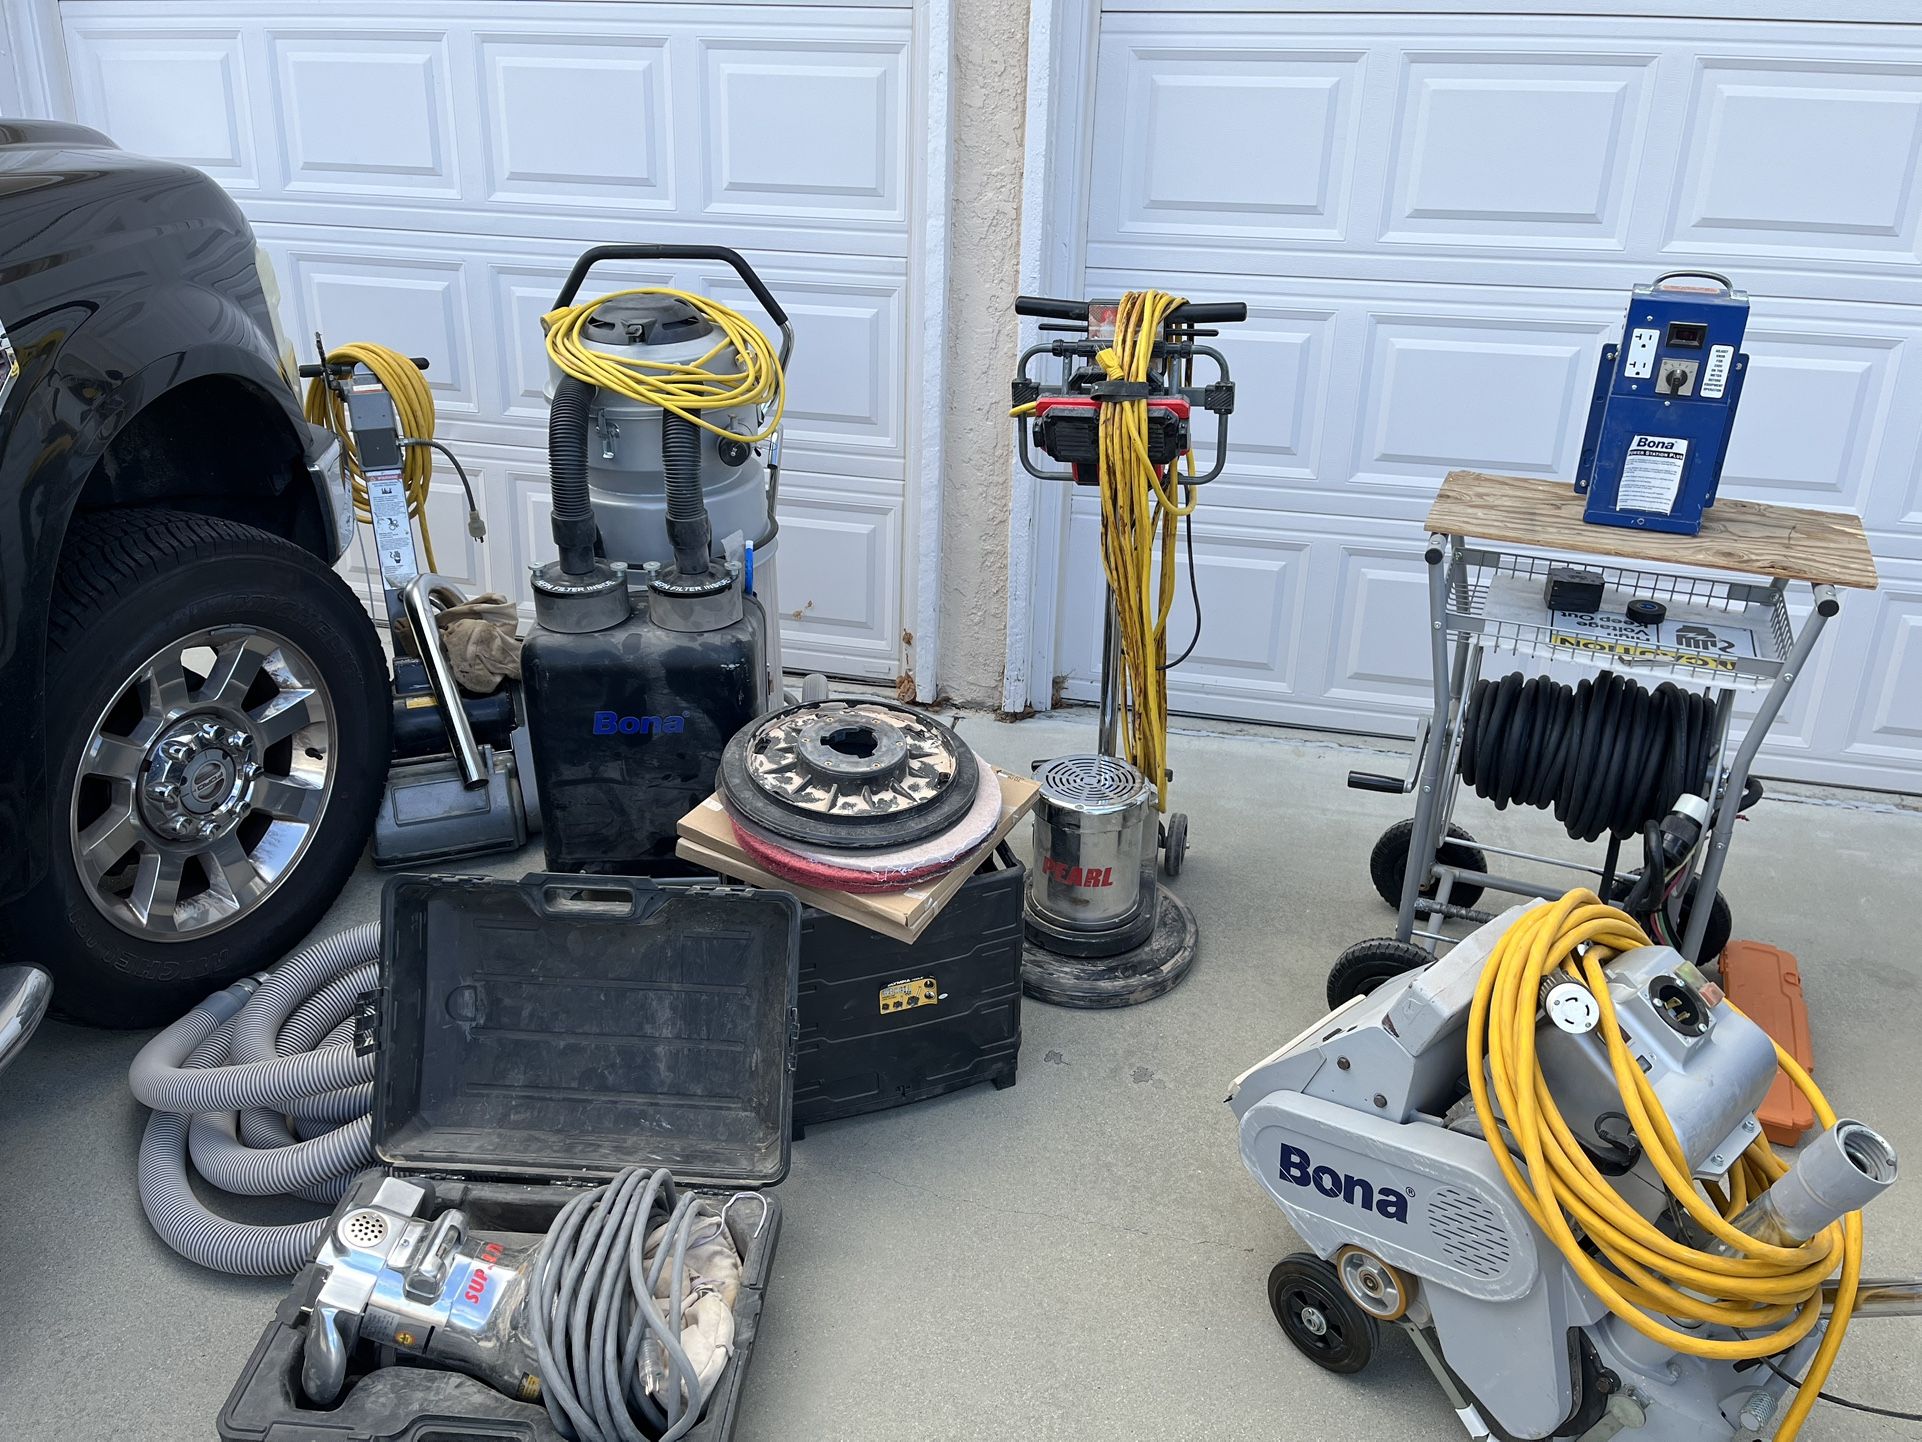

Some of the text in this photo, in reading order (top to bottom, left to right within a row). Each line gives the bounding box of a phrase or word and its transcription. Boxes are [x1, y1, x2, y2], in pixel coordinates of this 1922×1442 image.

[1560, 611, 1648, 629] Keep Out
[1576, 621, 1650, 637] Voltage
[1042, 855, 1114, 888] PEARL
